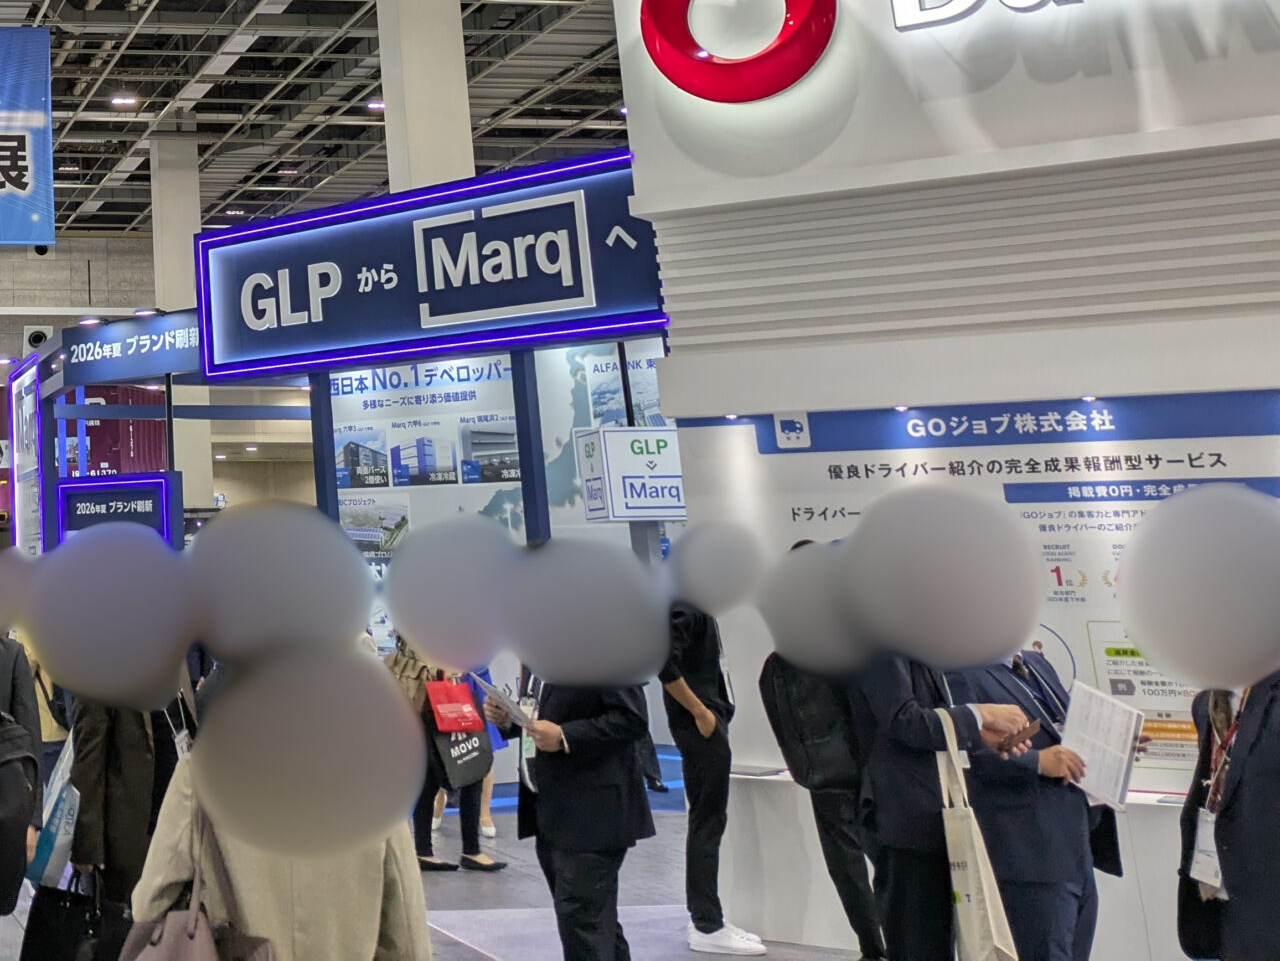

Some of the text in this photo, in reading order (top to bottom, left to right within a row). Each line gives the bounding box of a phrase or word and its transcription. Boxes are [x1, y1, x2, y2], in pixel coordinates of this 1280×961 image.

[240, 261, 342, 331] GLP
[357, 263, 398, 293] から
[429, 229, 574, 291] Marq
[70, 327, 199, 364] 2026年夏 ブランド刷新
[593, 360, 643, 373] ALFANK
[362, 390, 477, 410] 多様なニーズに寄り添う価値提供
[907, 408, 1115, 438] GOジョブ株式会社
[630, 439, 668, 455] GLP
[828, 452, 1228, 480] 優良ドライバー紹介の完全成果報酬型サービス
[629, 481, 681, 502] Marq
[1069, 484, 1197, 499] 掲載費0円・完全成
[77, 499, 153, 515] 2026年夏 ブランド刷新
[791, 506, 861, 521] ドライバー
[450, 737, 480, 758] MOVO
